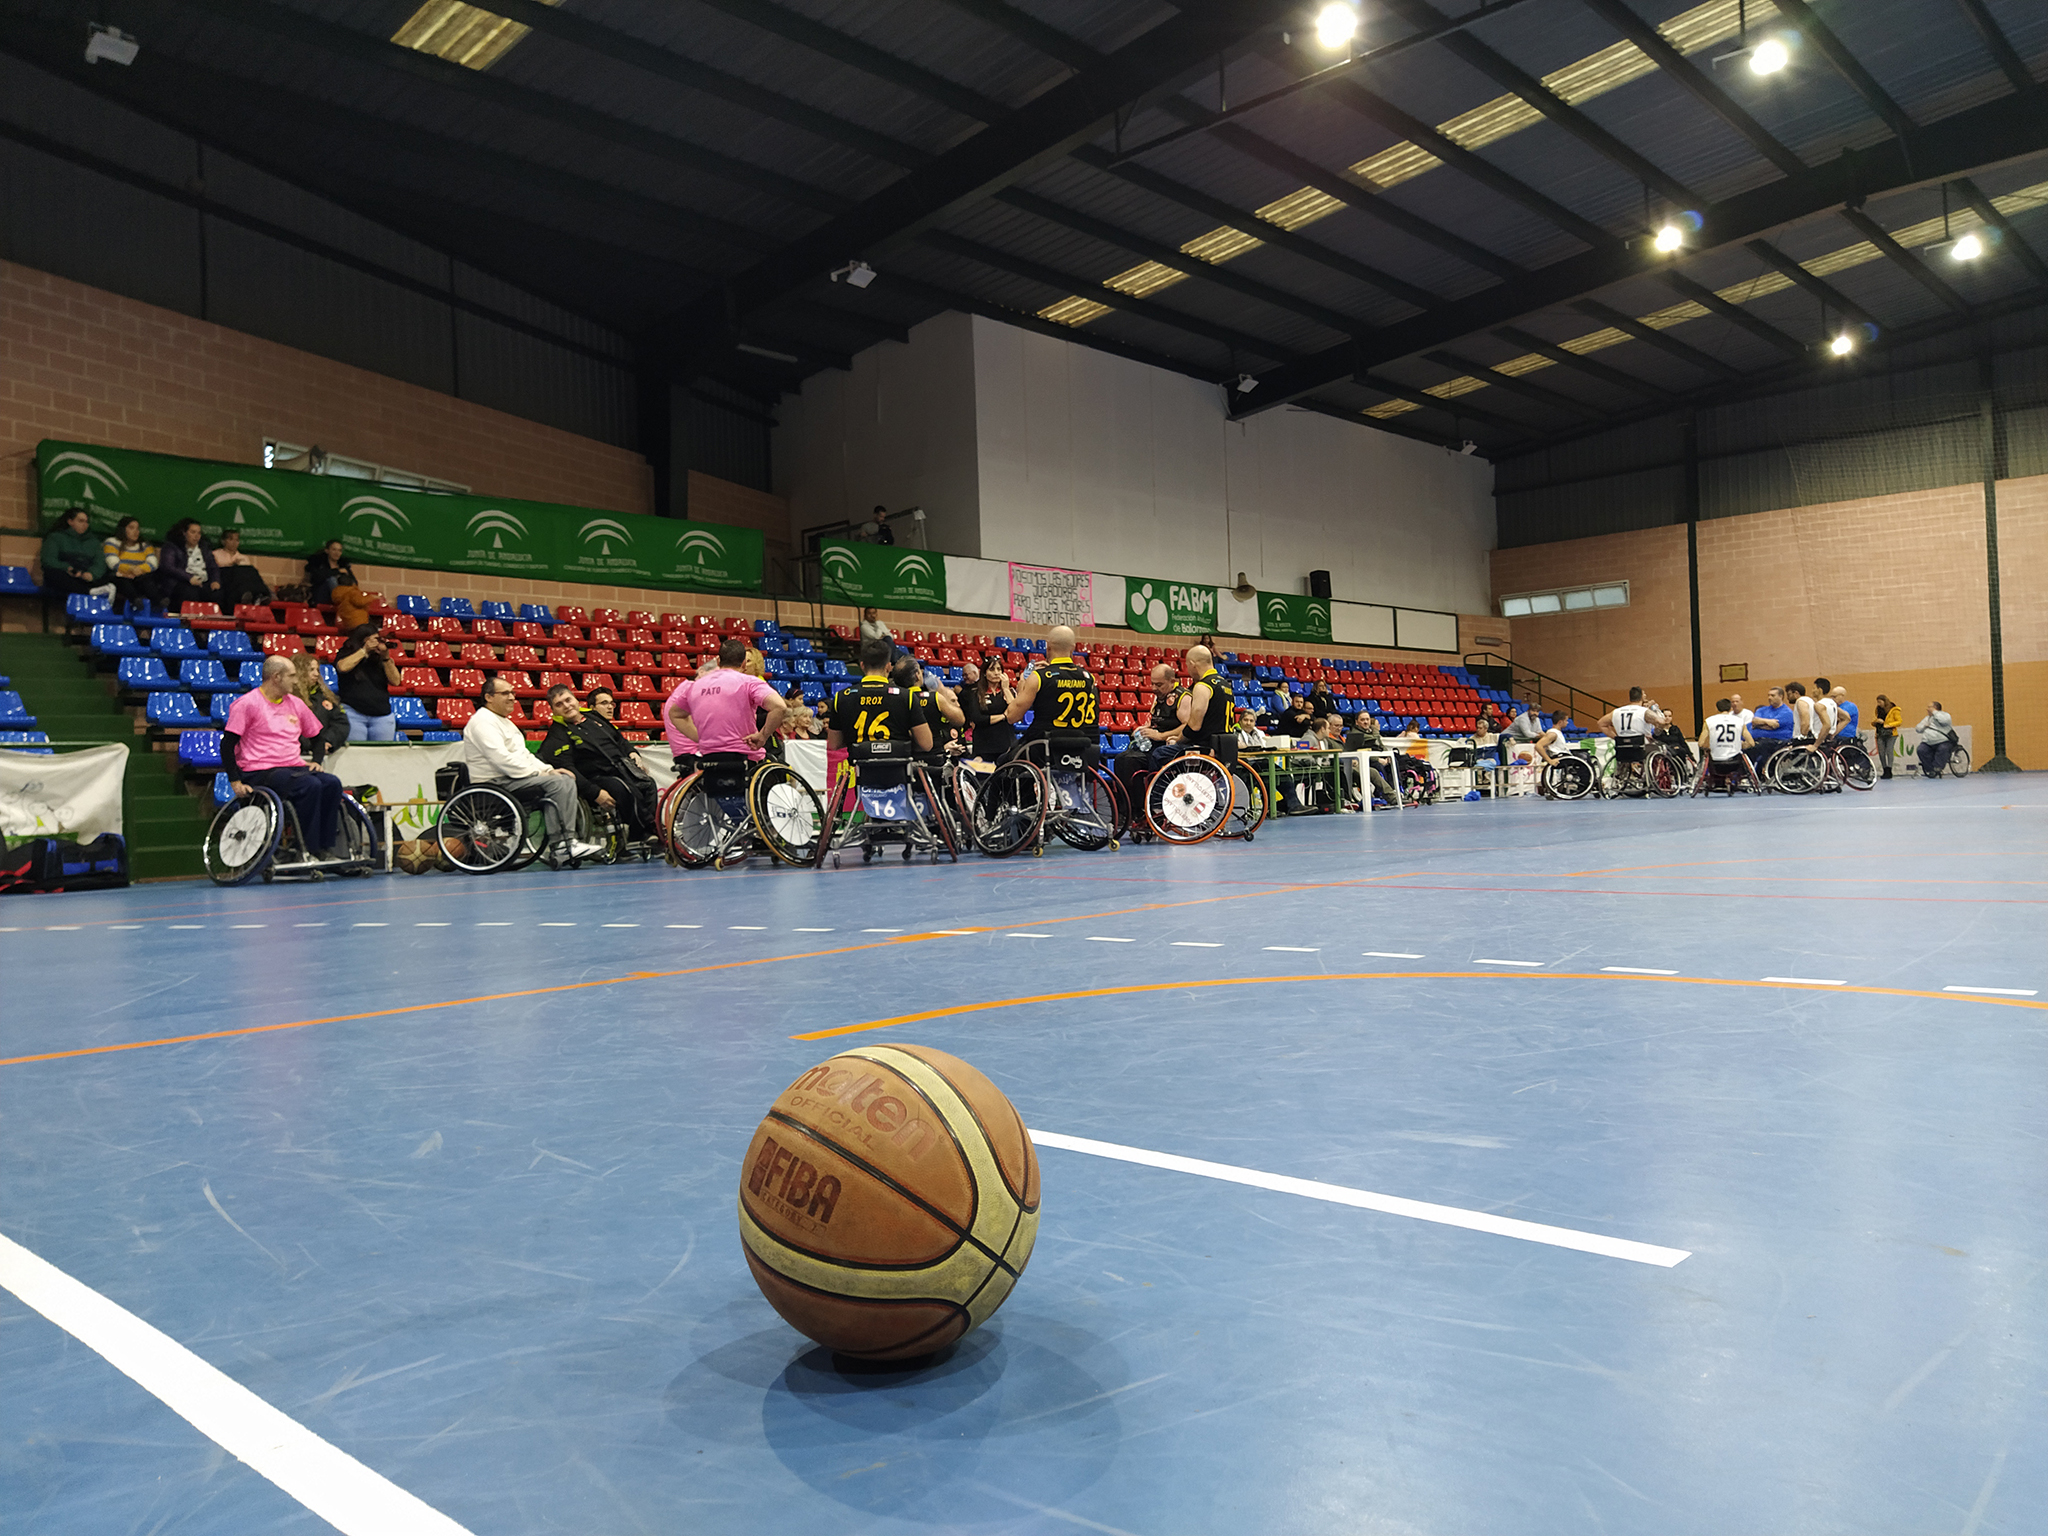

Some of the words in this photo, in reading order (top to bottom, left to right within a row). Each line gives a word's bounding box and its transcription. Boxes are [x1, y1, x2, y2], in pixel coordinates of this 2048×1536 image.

[1032, 585, 1078, 600] JUGADORAS
[1169, 585, 1213, 614] FABM
[1025, 609, 1081, 627] DEPORTISTAS
[701, 686, 721, 696] PATO
[860, 696, 883, 705] BROX
[854, 710, 890, 743] 16
[1620, 712, 1634, 731] 17
[1715, 724, 1736, 743] 25
[871, 799, 896, 818] 16
[788, 1066, 936, 1162] molten
[790, 1096, 875, 1150] OFFICIAL
[764, 1146, 842, 1224] FIBA
